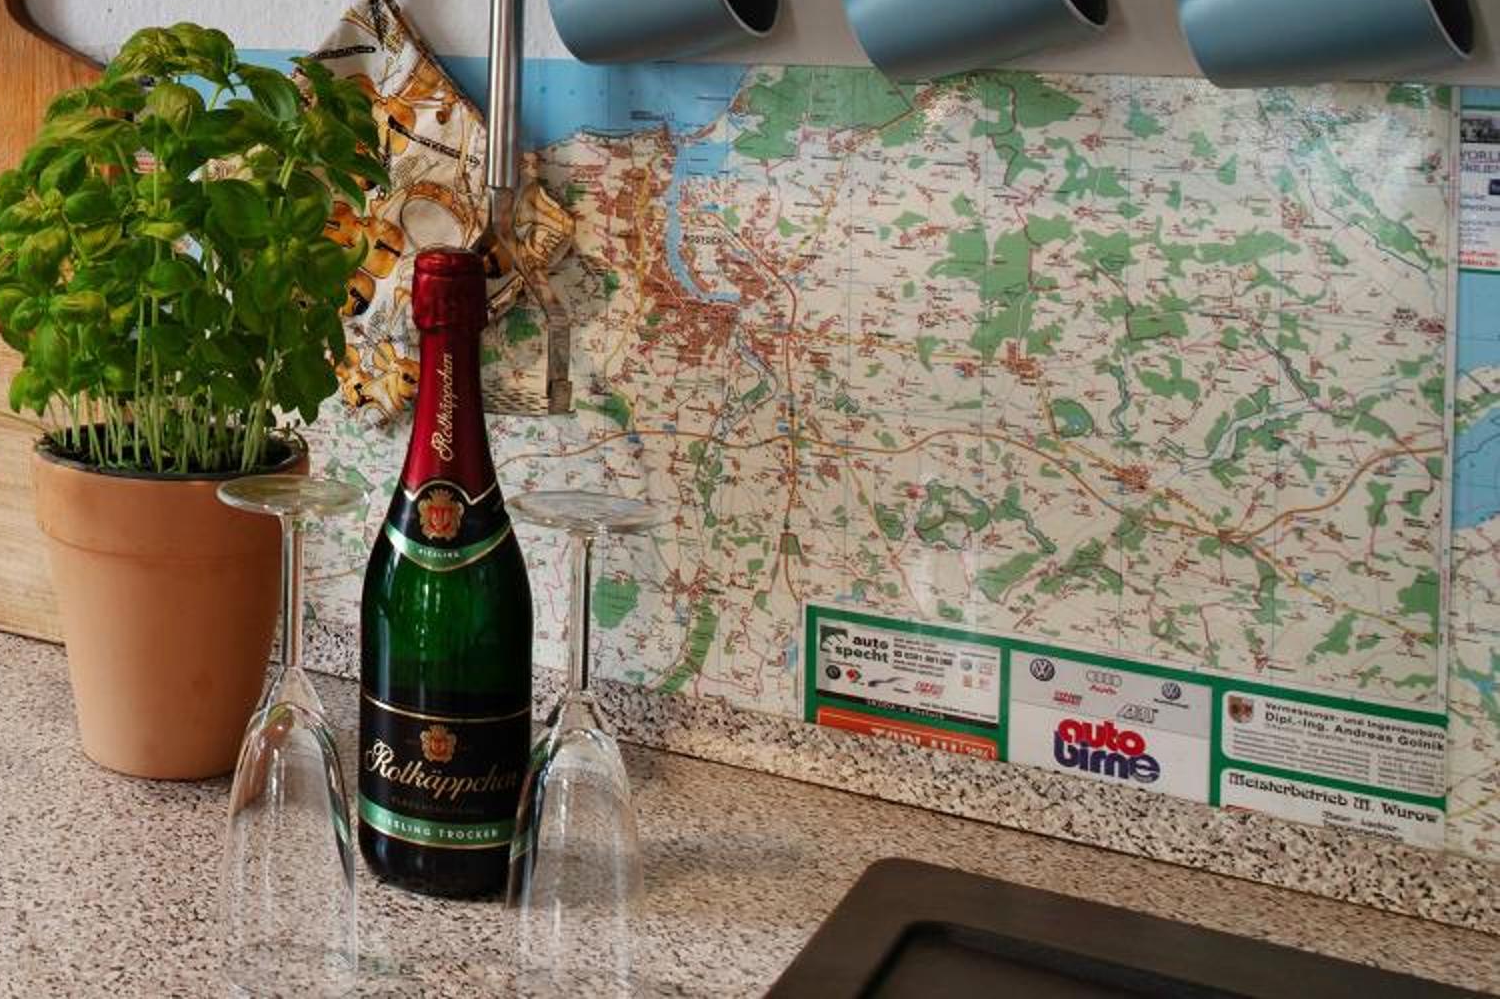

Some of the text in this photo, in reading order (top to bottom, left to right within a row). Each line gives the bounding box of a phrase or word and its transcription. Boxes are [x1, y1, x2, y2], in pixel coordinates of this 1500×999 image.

[835, 645, 889, 663] specht
[852, 635, 889, 650] auto
[1058, 719, 1146, 756] auto
[1335, 724, 1393, 744] Andreas
[366, 739, 518, 800] Rotkäppchen
[1054, 730, 1161, 783] birne
[1228, 772, 1349, 806] Meisterbetrieb
